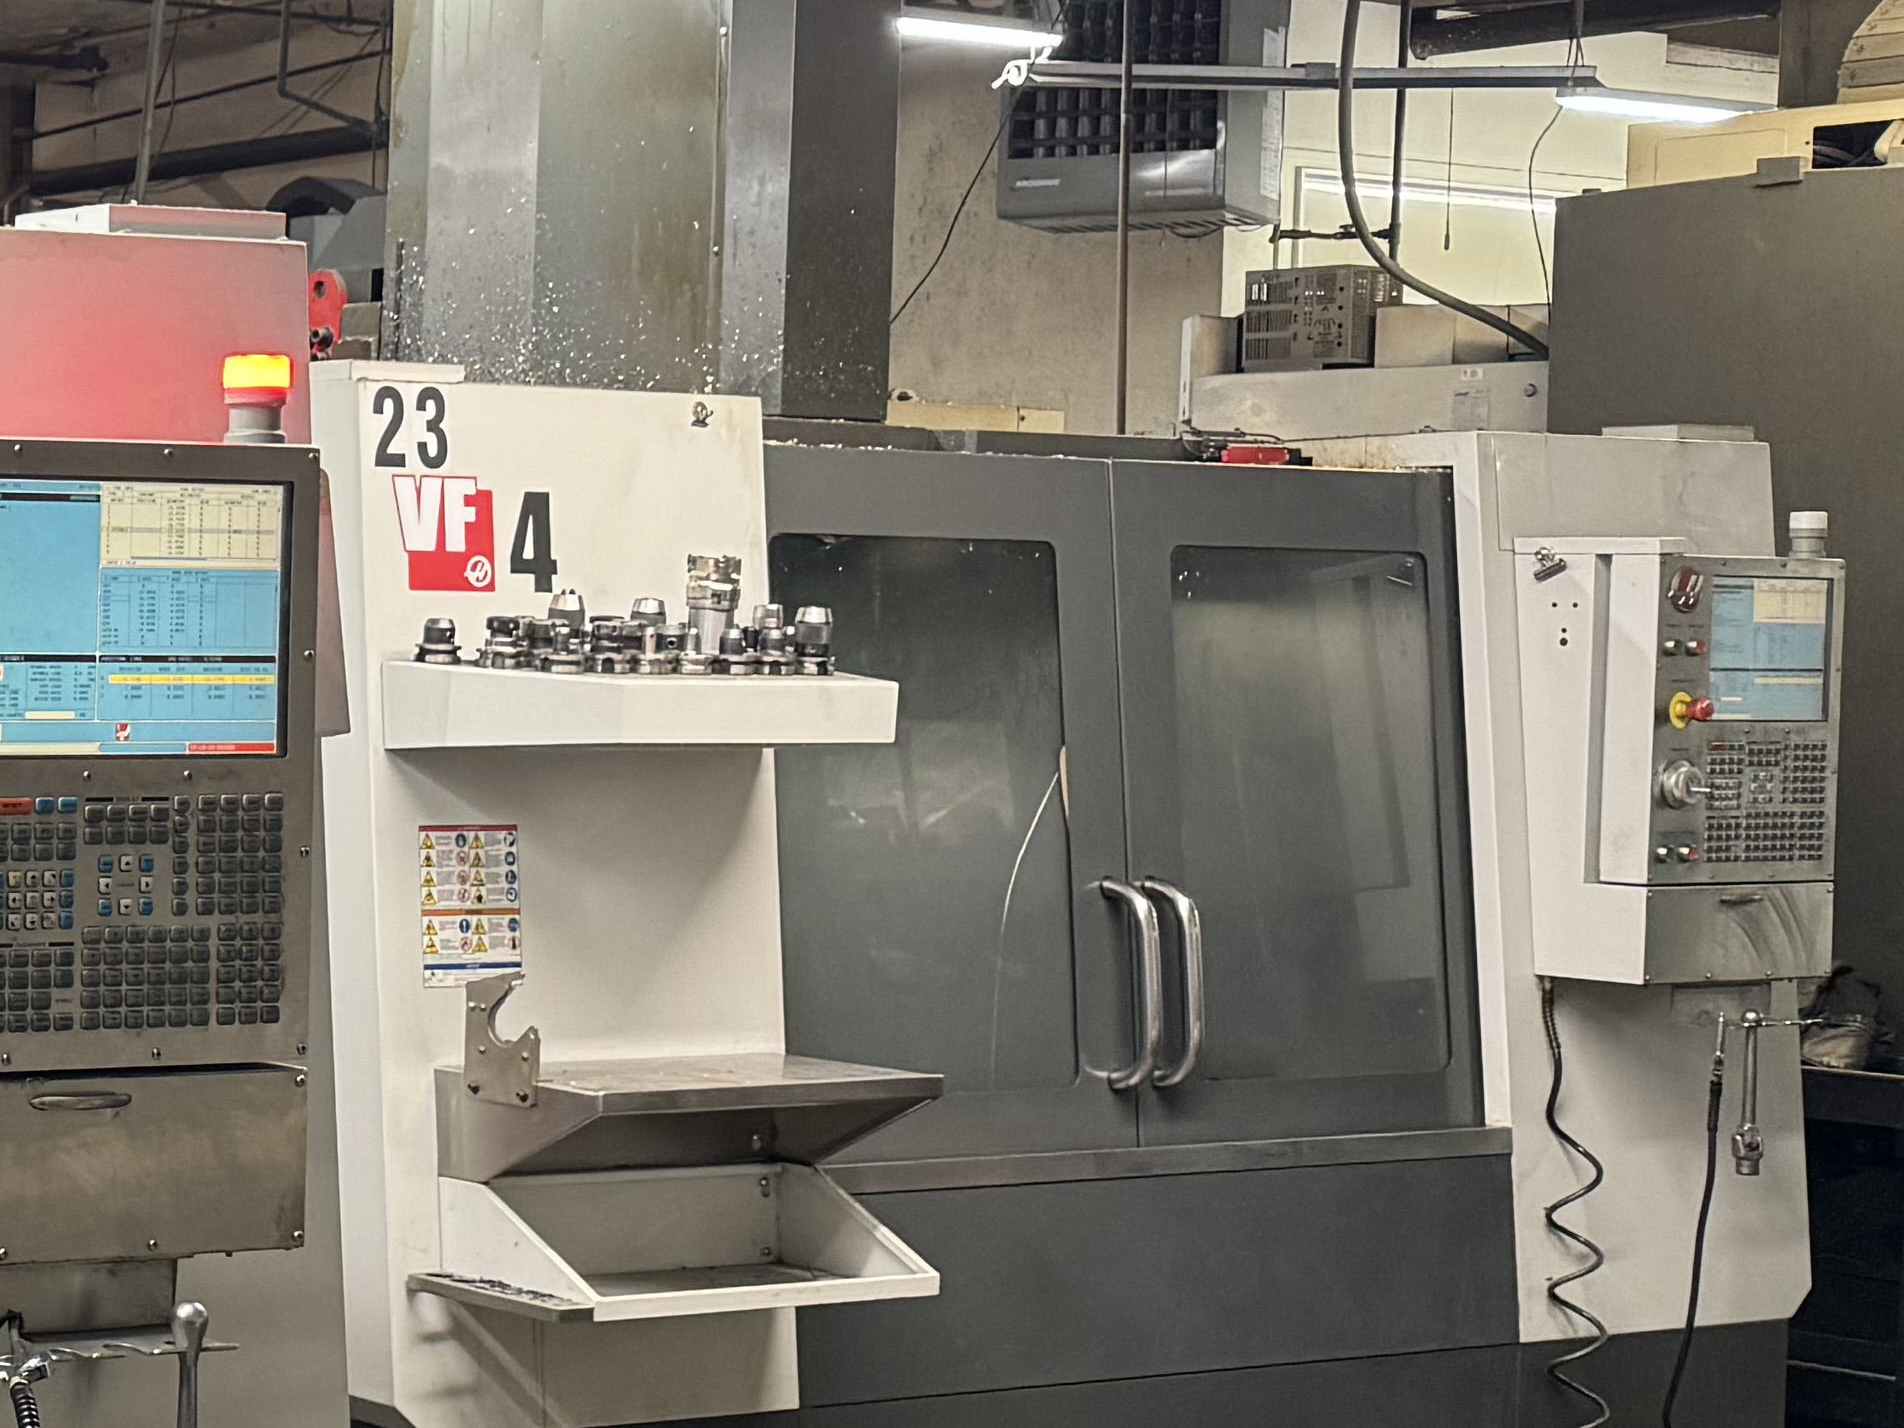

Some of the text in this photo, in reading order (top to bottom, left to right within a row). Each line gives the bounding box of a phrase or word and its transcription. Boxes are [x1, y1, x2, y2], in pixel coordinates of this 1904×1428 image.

[373, 386, 448, 469] 23
[392, 475, 558, 593] VF 4
